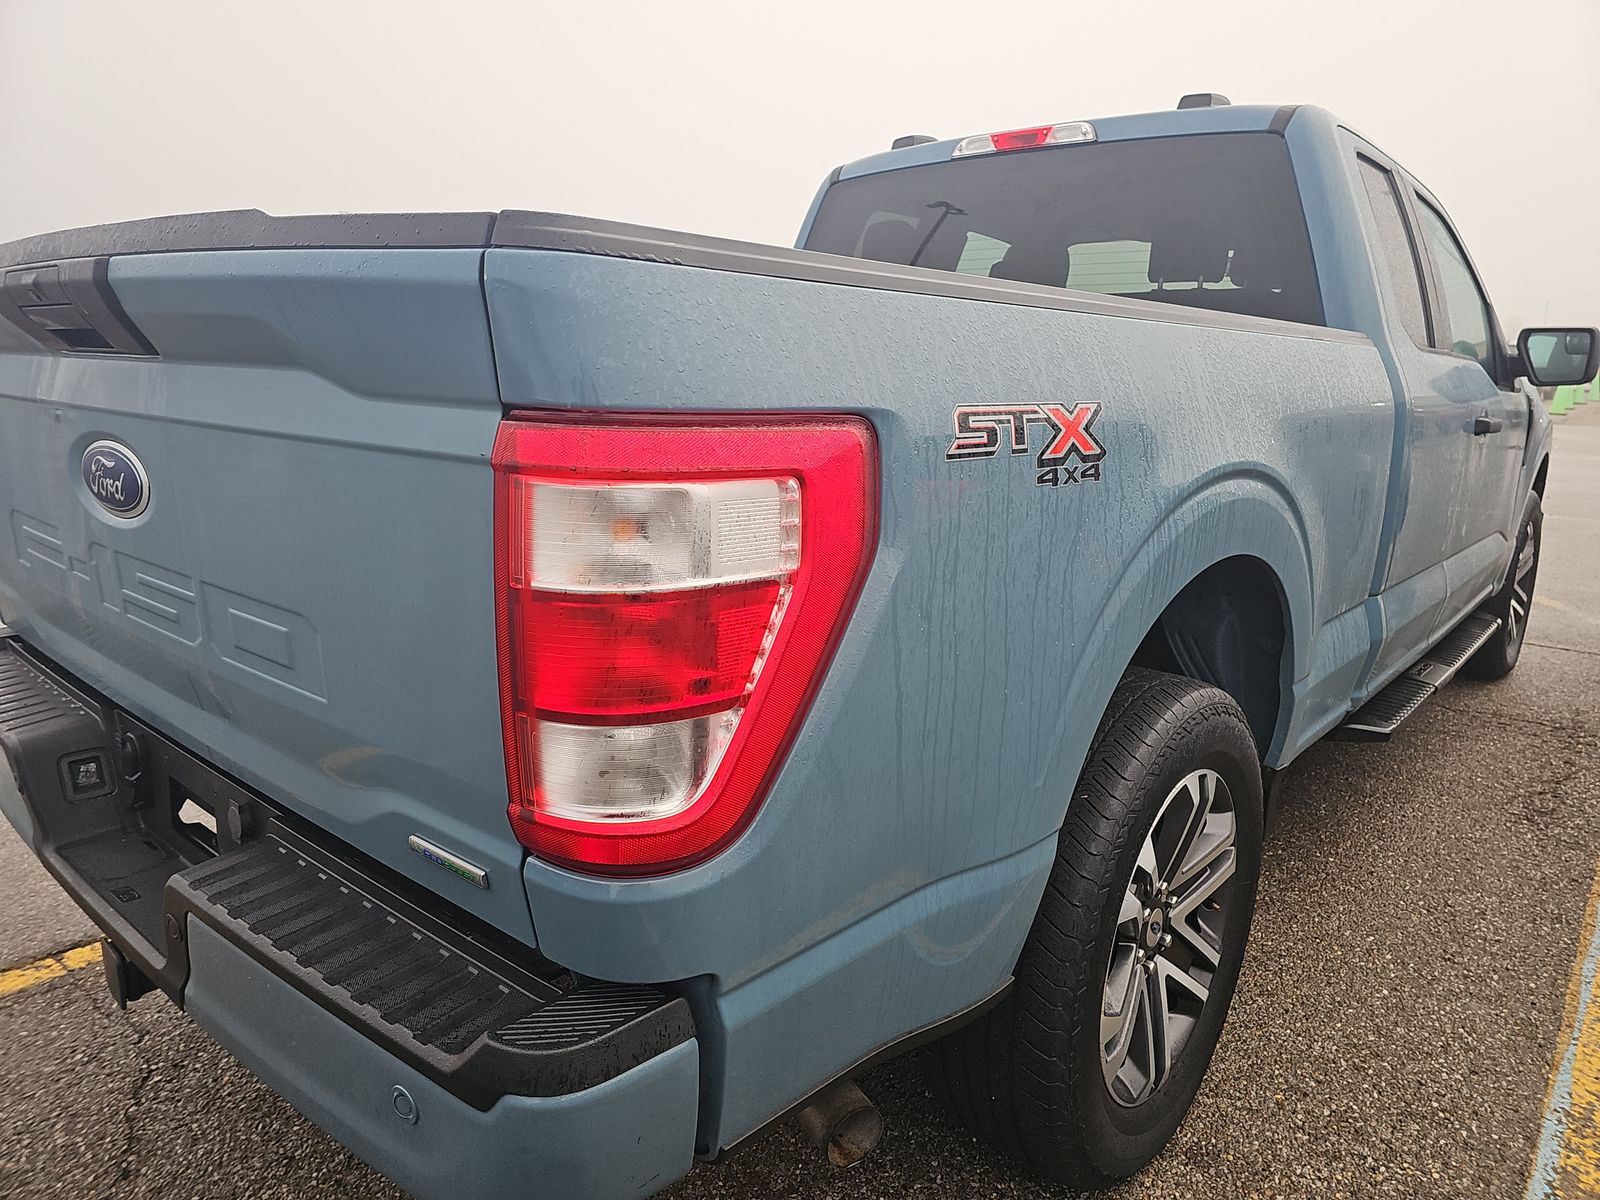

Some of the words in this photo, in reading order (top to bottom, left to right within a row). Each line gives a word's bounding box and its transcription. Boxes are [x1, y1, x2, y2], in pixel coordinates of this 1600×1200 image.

[945, 401, 1107, 467] STX
[90, 456, 126, 502] Ford
[10, 508, 328, 704] F-150
